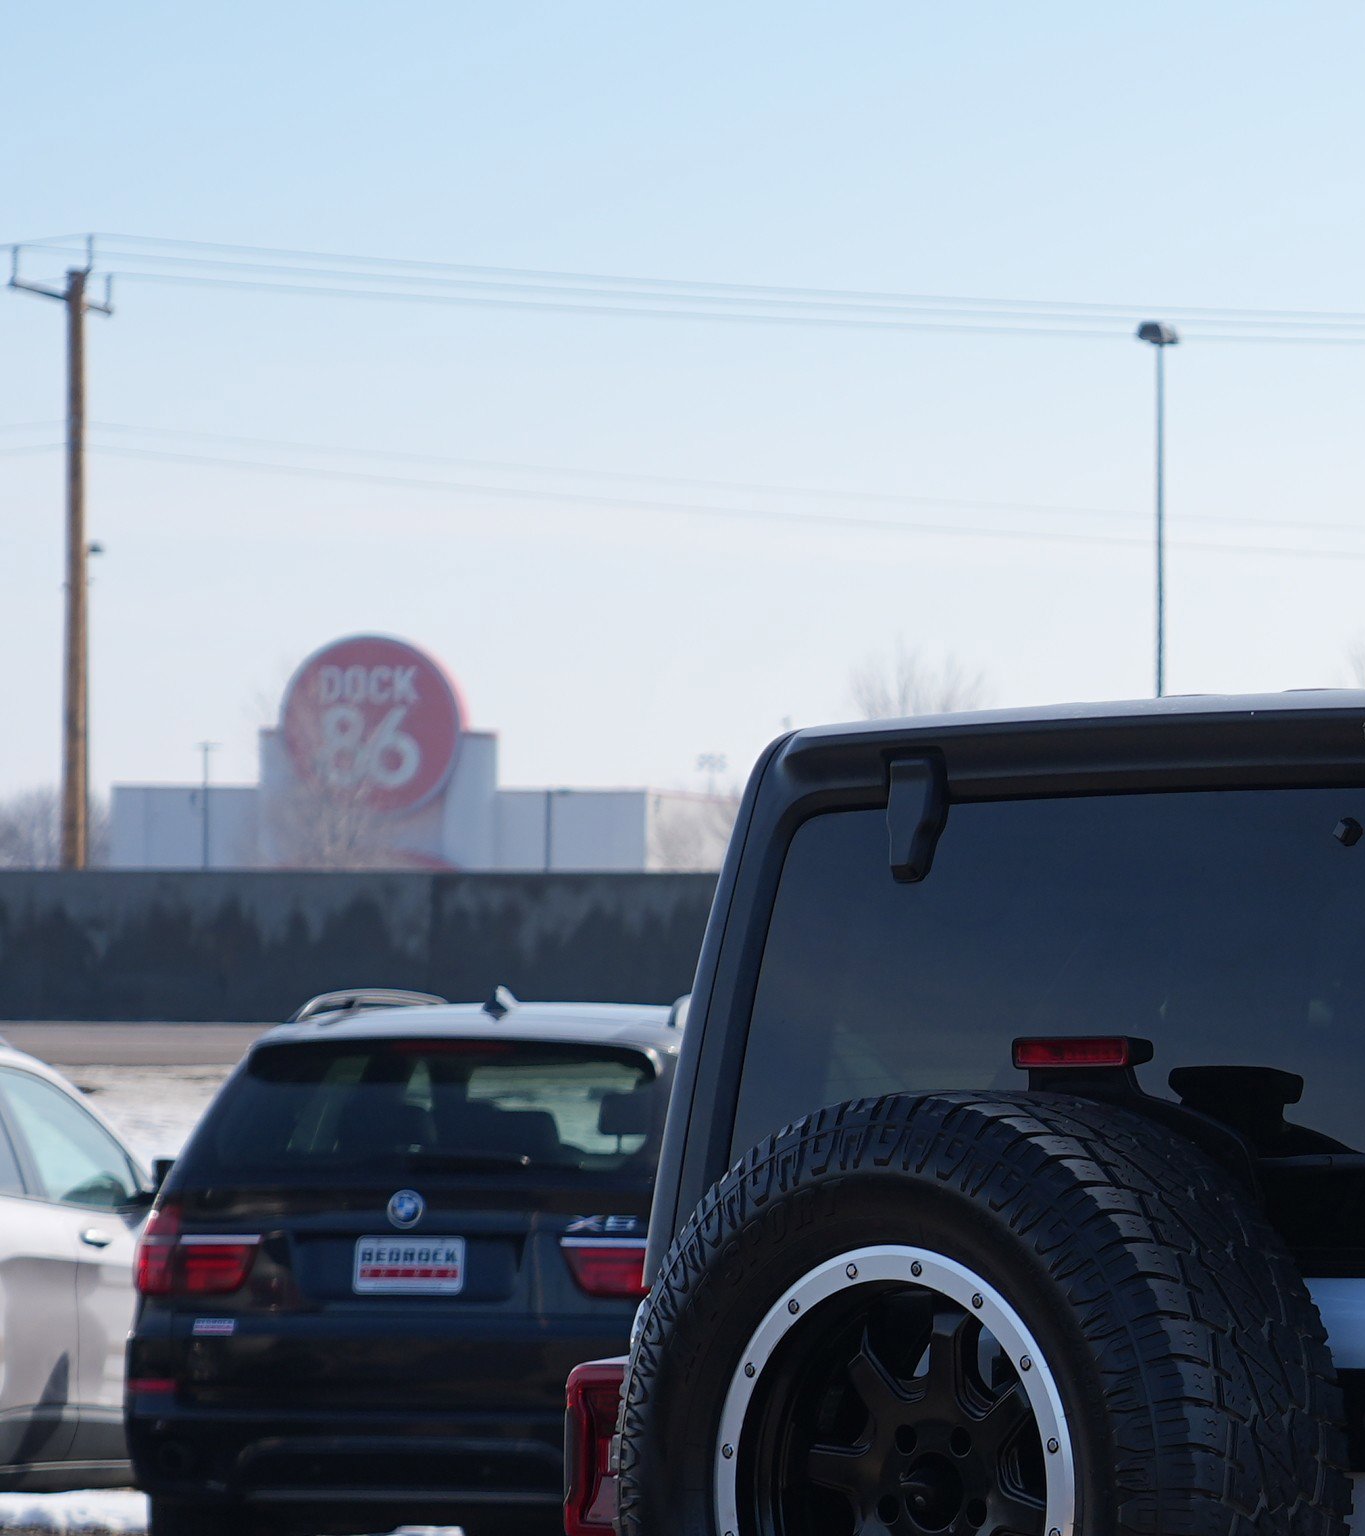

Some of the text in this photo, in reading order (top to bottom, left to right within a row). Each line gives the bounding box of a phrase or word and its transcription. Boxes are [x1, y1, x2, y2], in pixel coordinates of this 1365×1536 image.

[318, 664, 421, 705] DOCK
[318, 705, 422, 789] 86
[565, 1214, 638, 1232] X5
[361, 1247, 458, 1262] BEDROCK
